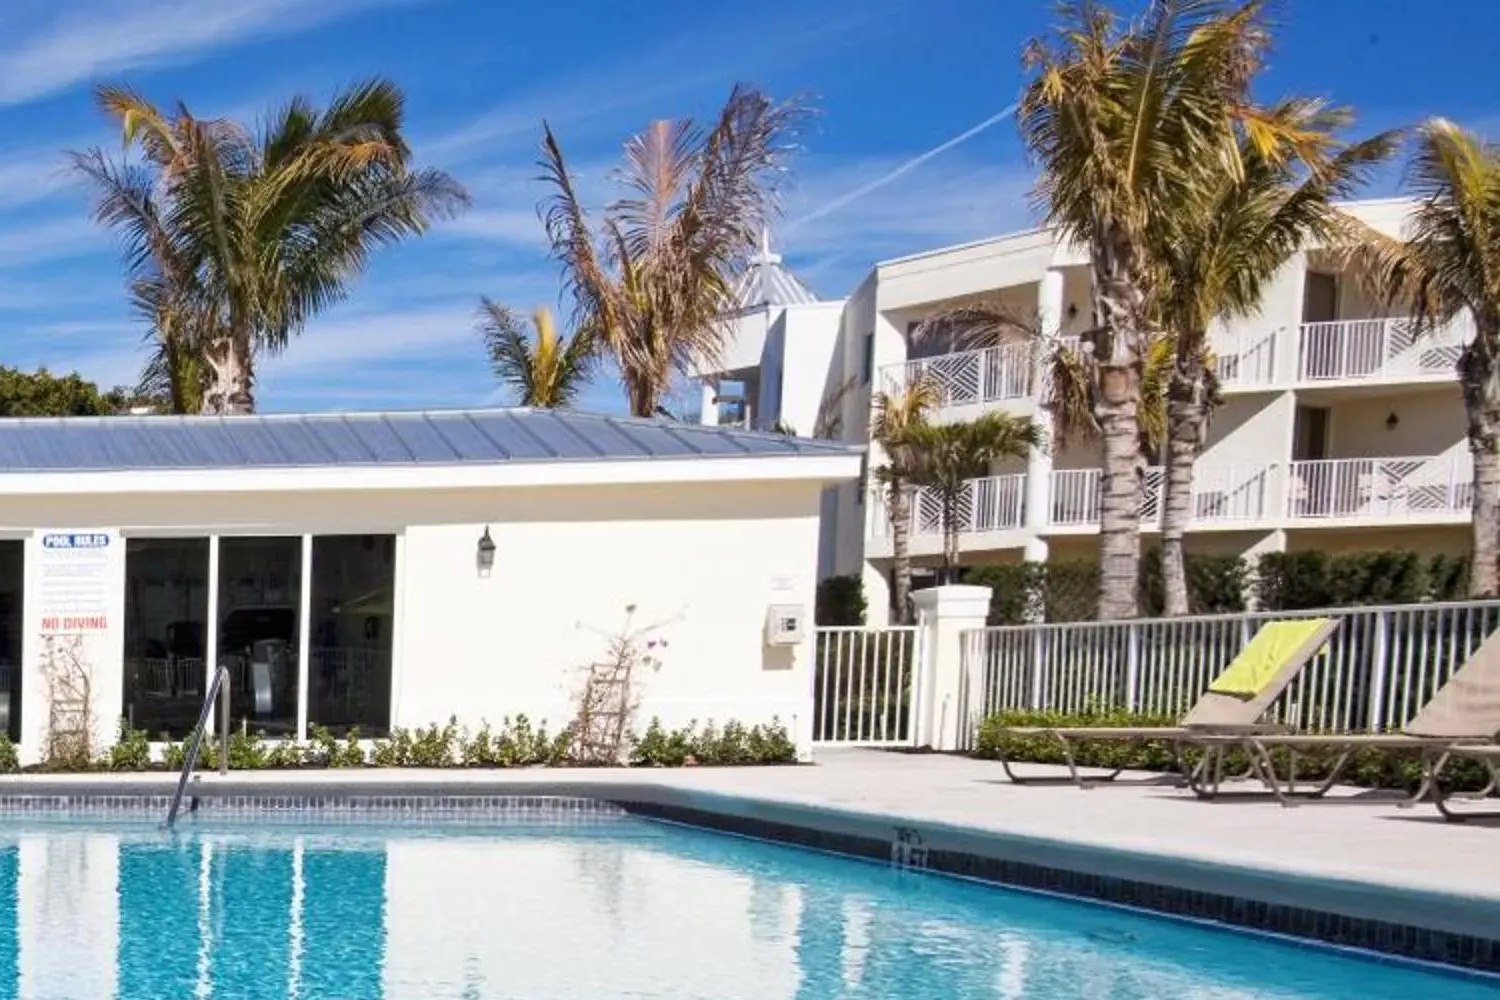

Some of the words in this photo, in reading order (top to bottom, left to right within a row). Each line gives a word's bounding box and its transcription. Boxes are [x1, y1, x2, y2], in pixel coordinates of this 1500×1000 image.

[45, 535, 71, 547] POOL
[73, 535, 106, 547] RULES
[42, 617, 59, 629] NO
[63, 616, 107, 629] DIVING
